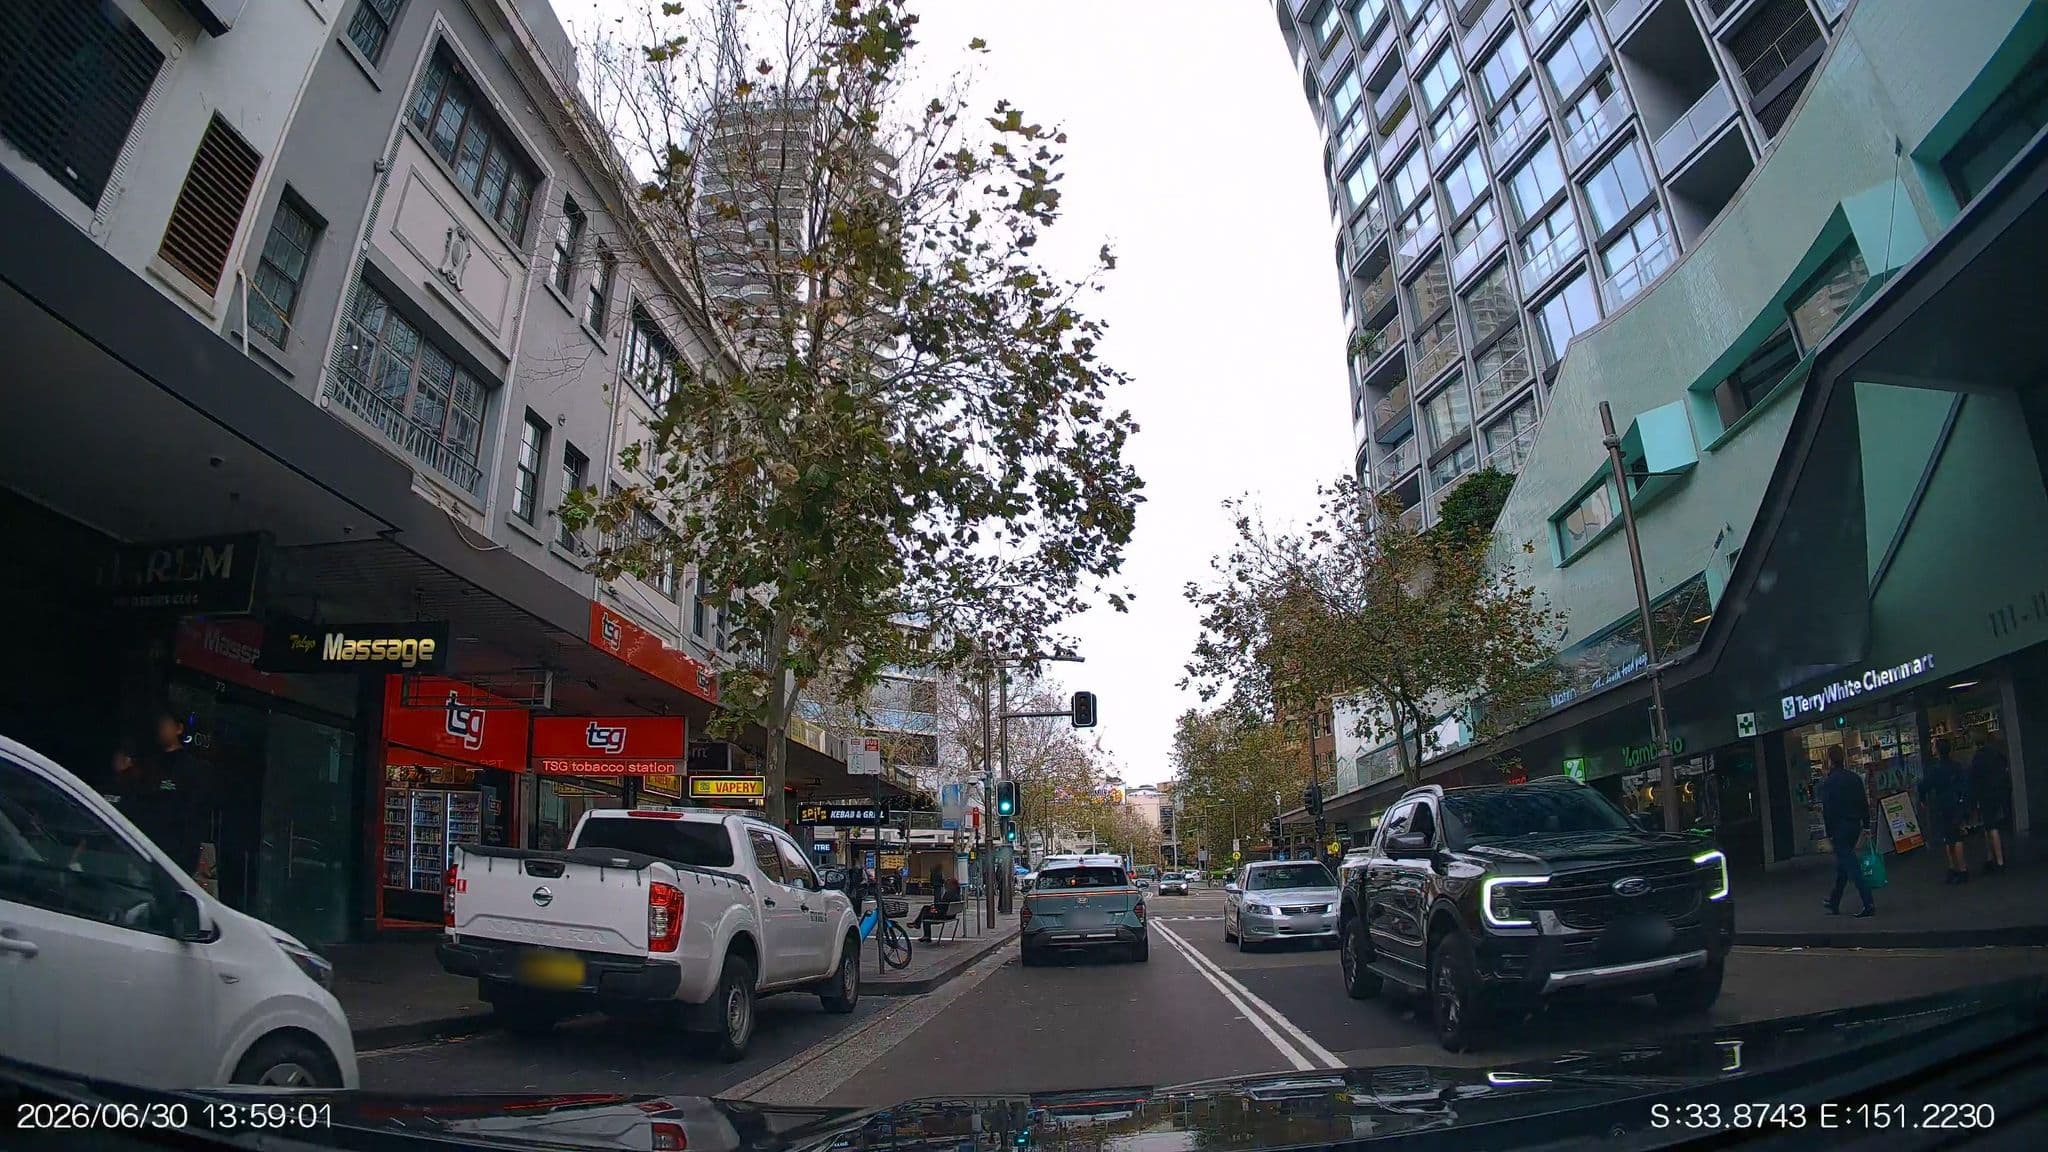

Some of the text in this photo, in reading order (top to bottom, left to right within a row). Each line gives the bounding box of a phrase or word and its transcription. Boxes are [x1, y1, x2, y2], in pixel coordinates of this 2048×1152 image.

[322, 632, 436, 668] Massage
[1795, 653, 1935, 714] TerryWhite Chemmart
[446, 690, 486, 750] tsg
[586, 721, 627, 754] tsg
[1622, 737, 1684, 768] Zambo
[543, 760, 676, 773] TSG tobacco station
[715, 782, 757, 793] VAPERY
[830, 810, 855, 819] KEBAB
